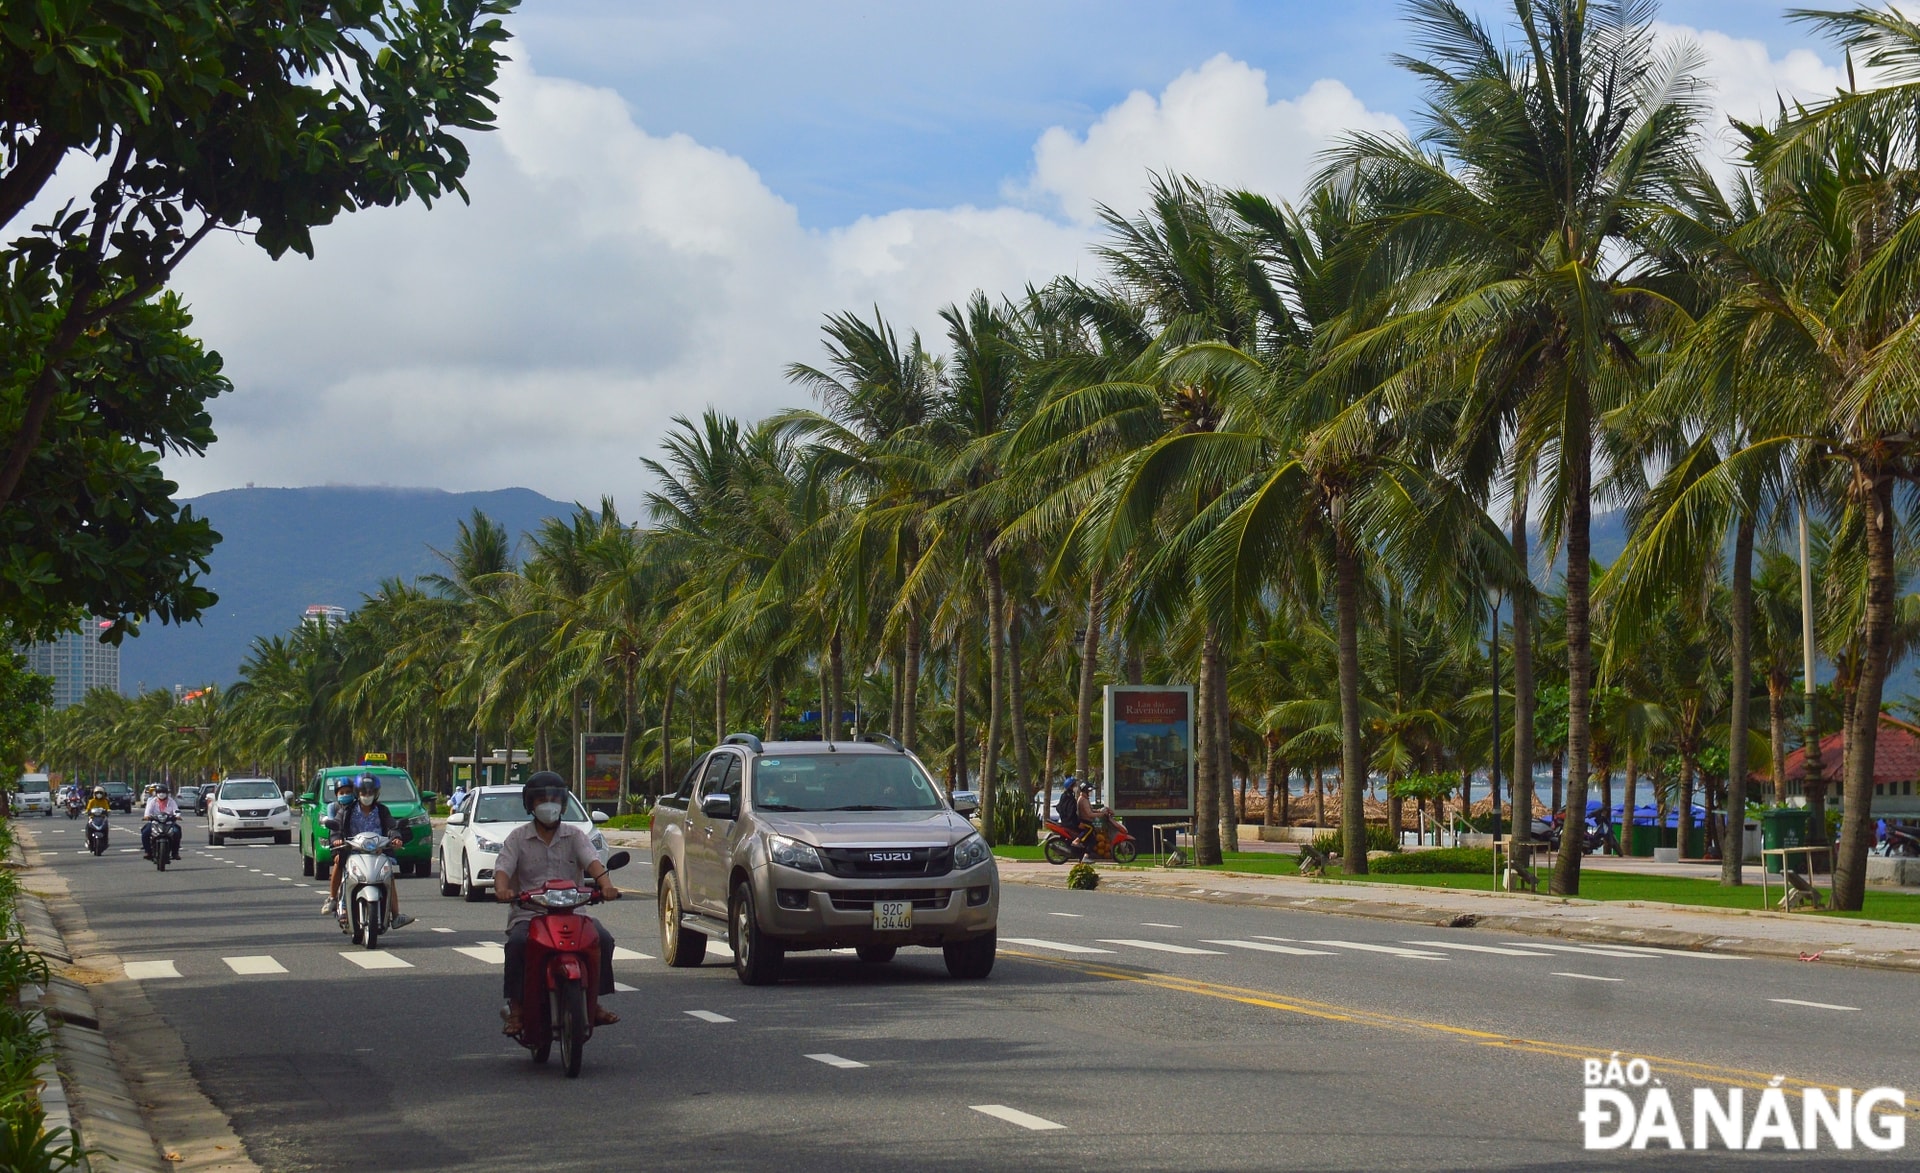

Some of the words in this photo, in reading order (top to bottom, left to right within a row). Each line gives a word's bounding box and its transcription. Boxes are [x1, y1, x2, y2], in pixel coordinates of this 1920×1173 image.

[1126, 704, 1176, 715] Ravenstone
[869, 852, 911, 861] ISUZU
[882, 903, 903, 916] 92C
